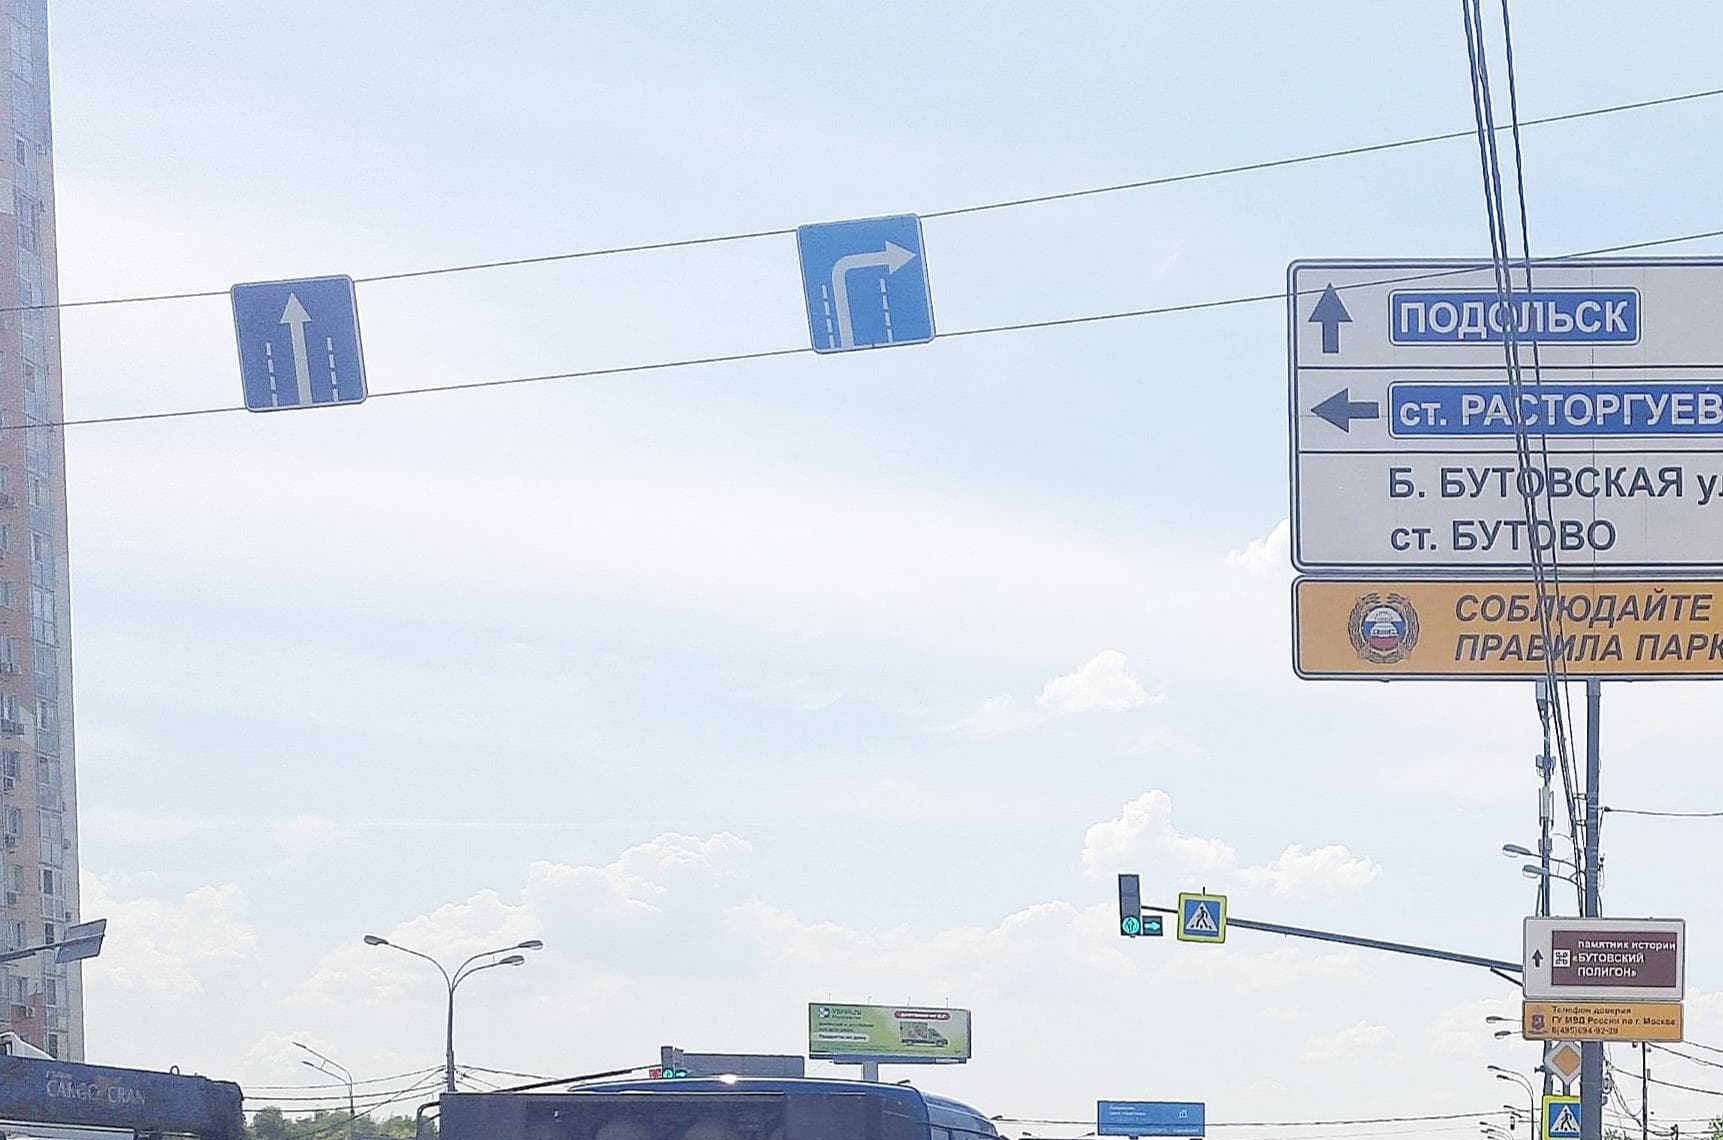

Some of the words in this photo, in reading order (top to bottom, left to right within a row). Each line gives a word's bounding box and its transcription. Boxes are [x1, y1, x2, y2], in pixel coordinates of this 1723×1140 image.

[1399, 300, 1628, 338] ПОДОЛЬСК
[1399, 401, 1448, 426] ст.
[1389, 468, 1426, 498] Б.
[1440, 466, 1684, 499] БУТОВСКАЯ
[1390, 525, 1438, 551] ст.
[1451, 519, 1617, 551] БУТОВО
[1454, 588, 1713, 627] СОБЛЮДАЙТЕ
[1454, 633, 1623, 662] ПРАВИЛА
[1572, 952, 1644, 963] «БУТОВСКИЙ
[1577, 940, 1629, 950] памятник
[1631, 941, 1677, 951] истории
[1577, 966, 1637, 977] ПОЛИГОН»
